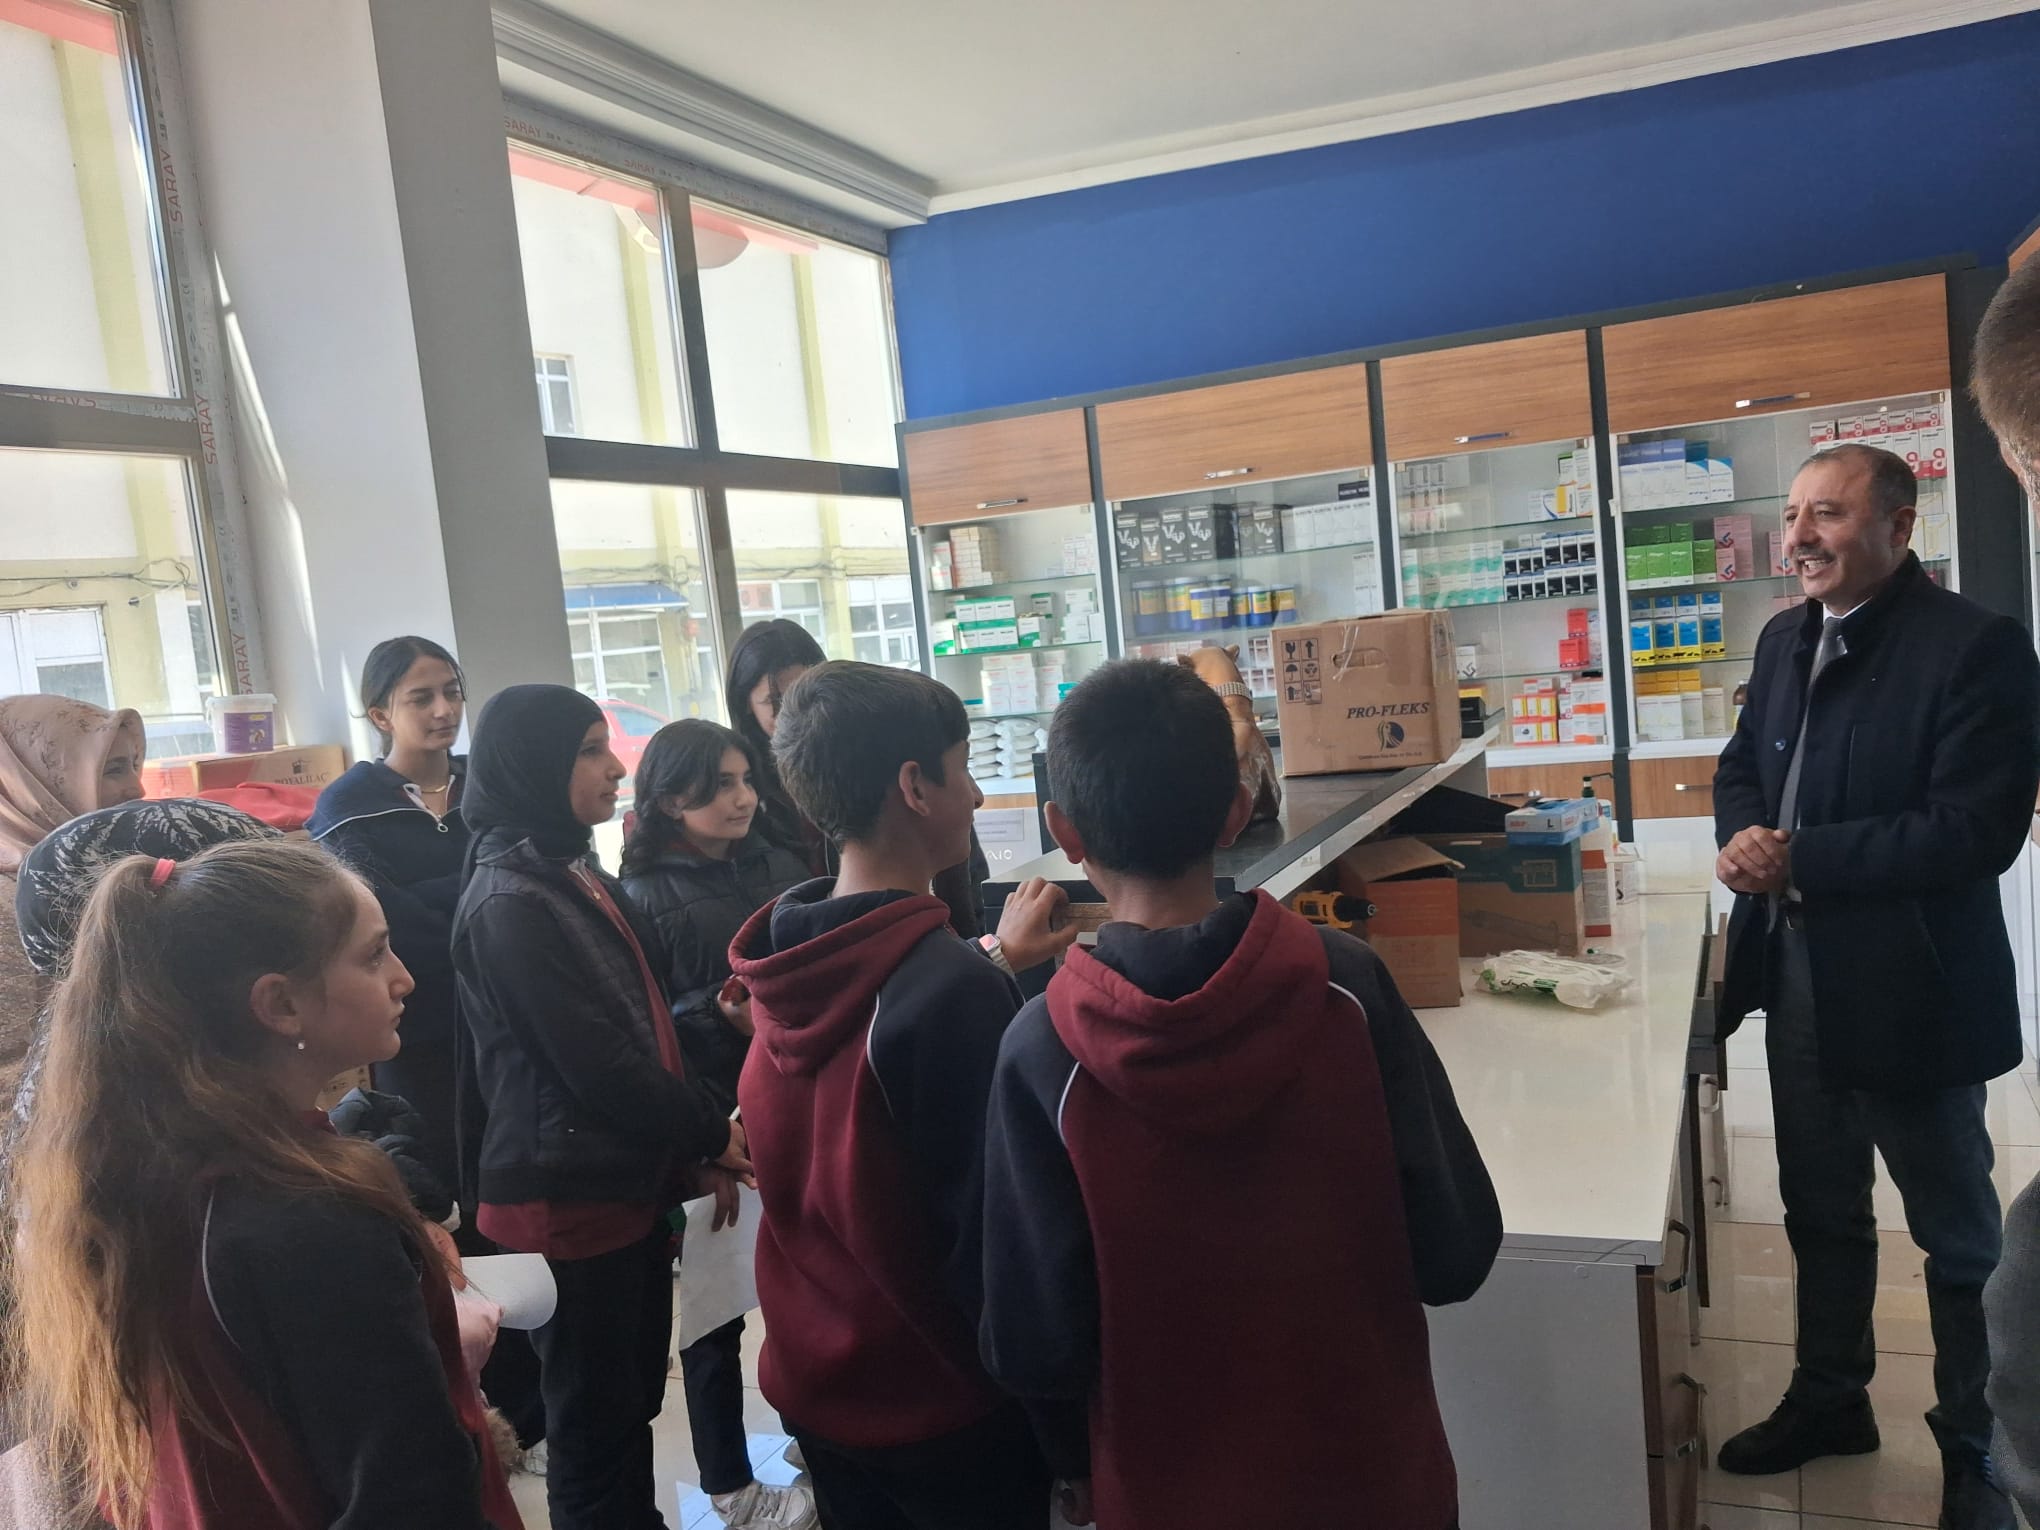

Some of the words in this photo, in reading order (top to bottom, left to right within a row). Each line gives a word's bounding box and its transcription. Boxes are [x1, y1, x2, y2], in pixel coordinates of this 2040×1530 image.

[160, 149, 183, 222] SARAY
[194, 391, 218, 464] SARAY
[1346, 702, 1430, 719] PRO-FLEKS
[1547, 818, 1554, 828] L
